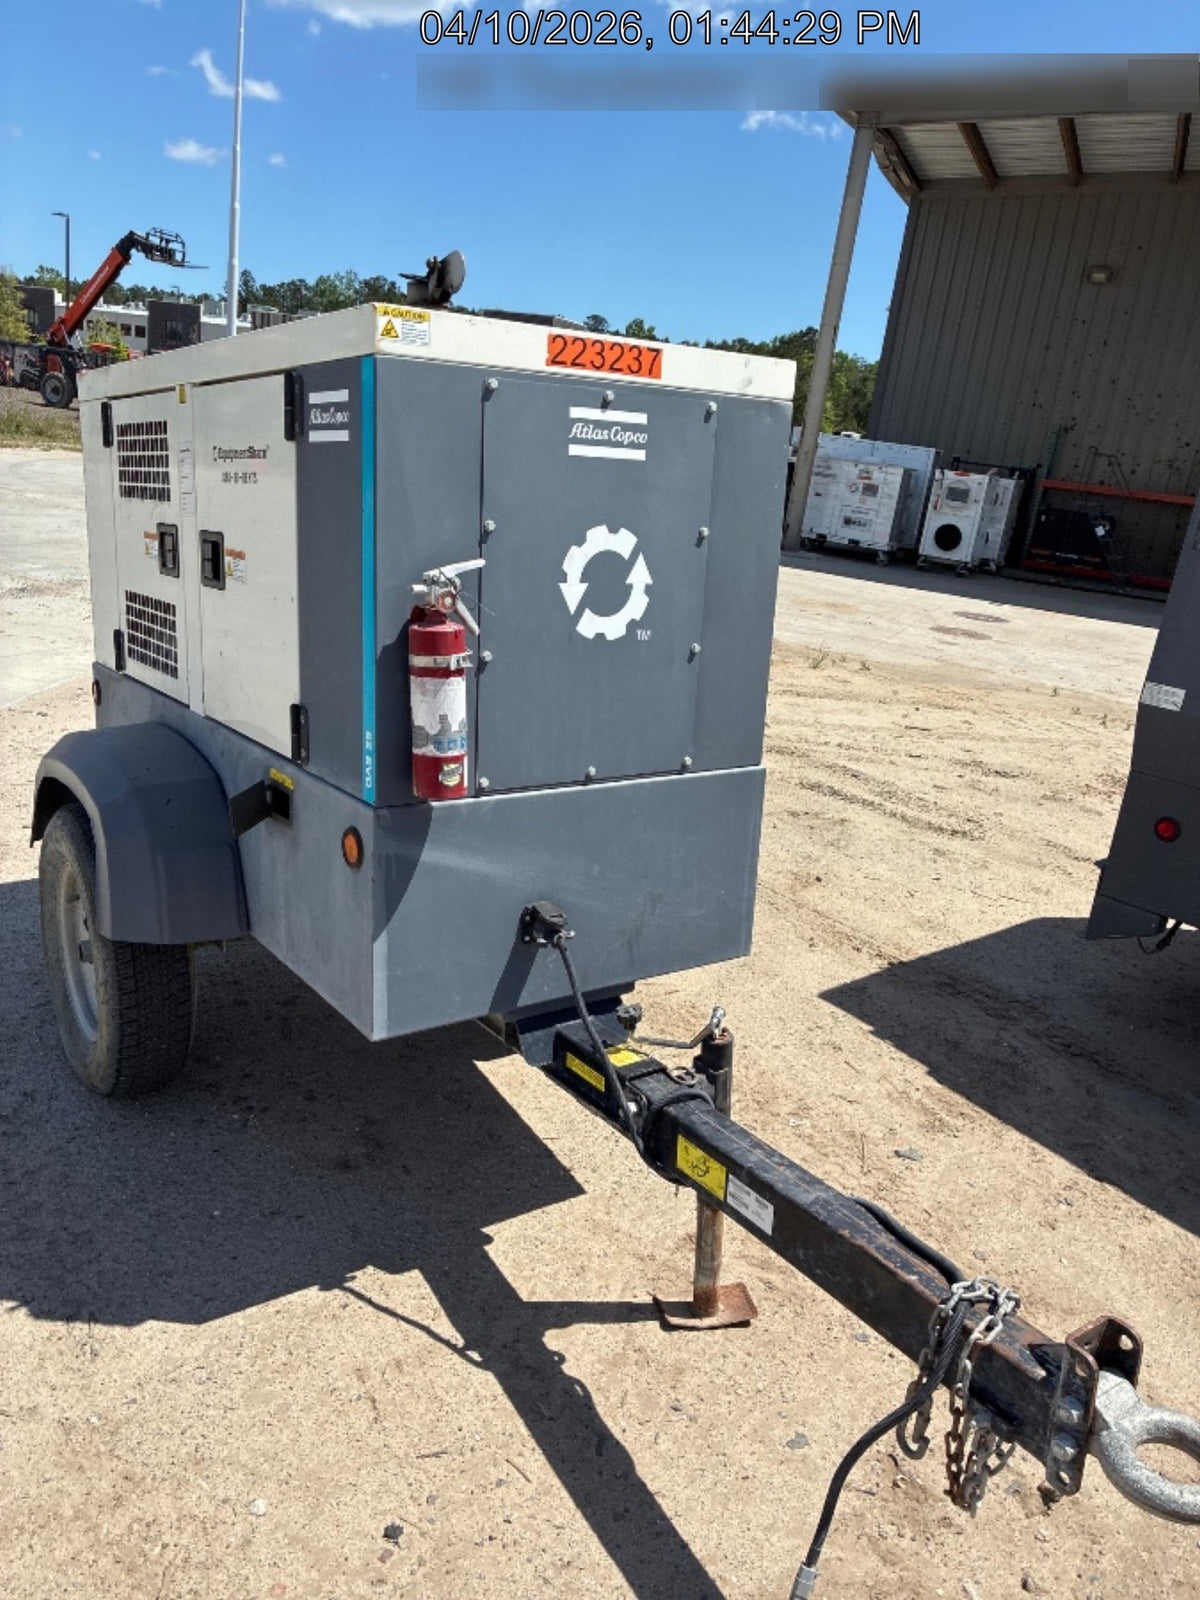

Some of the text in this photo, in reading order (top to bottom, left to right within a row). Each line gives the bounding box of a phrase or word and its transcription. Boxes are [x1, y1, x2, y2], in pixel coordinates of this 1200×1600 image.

[391, 307, 426, 320] CAUTION
[551, 335, 660, 376] 223237
[568, 422, 648, 445] Atlas Copco
[636, 629, 652, 641] TM
